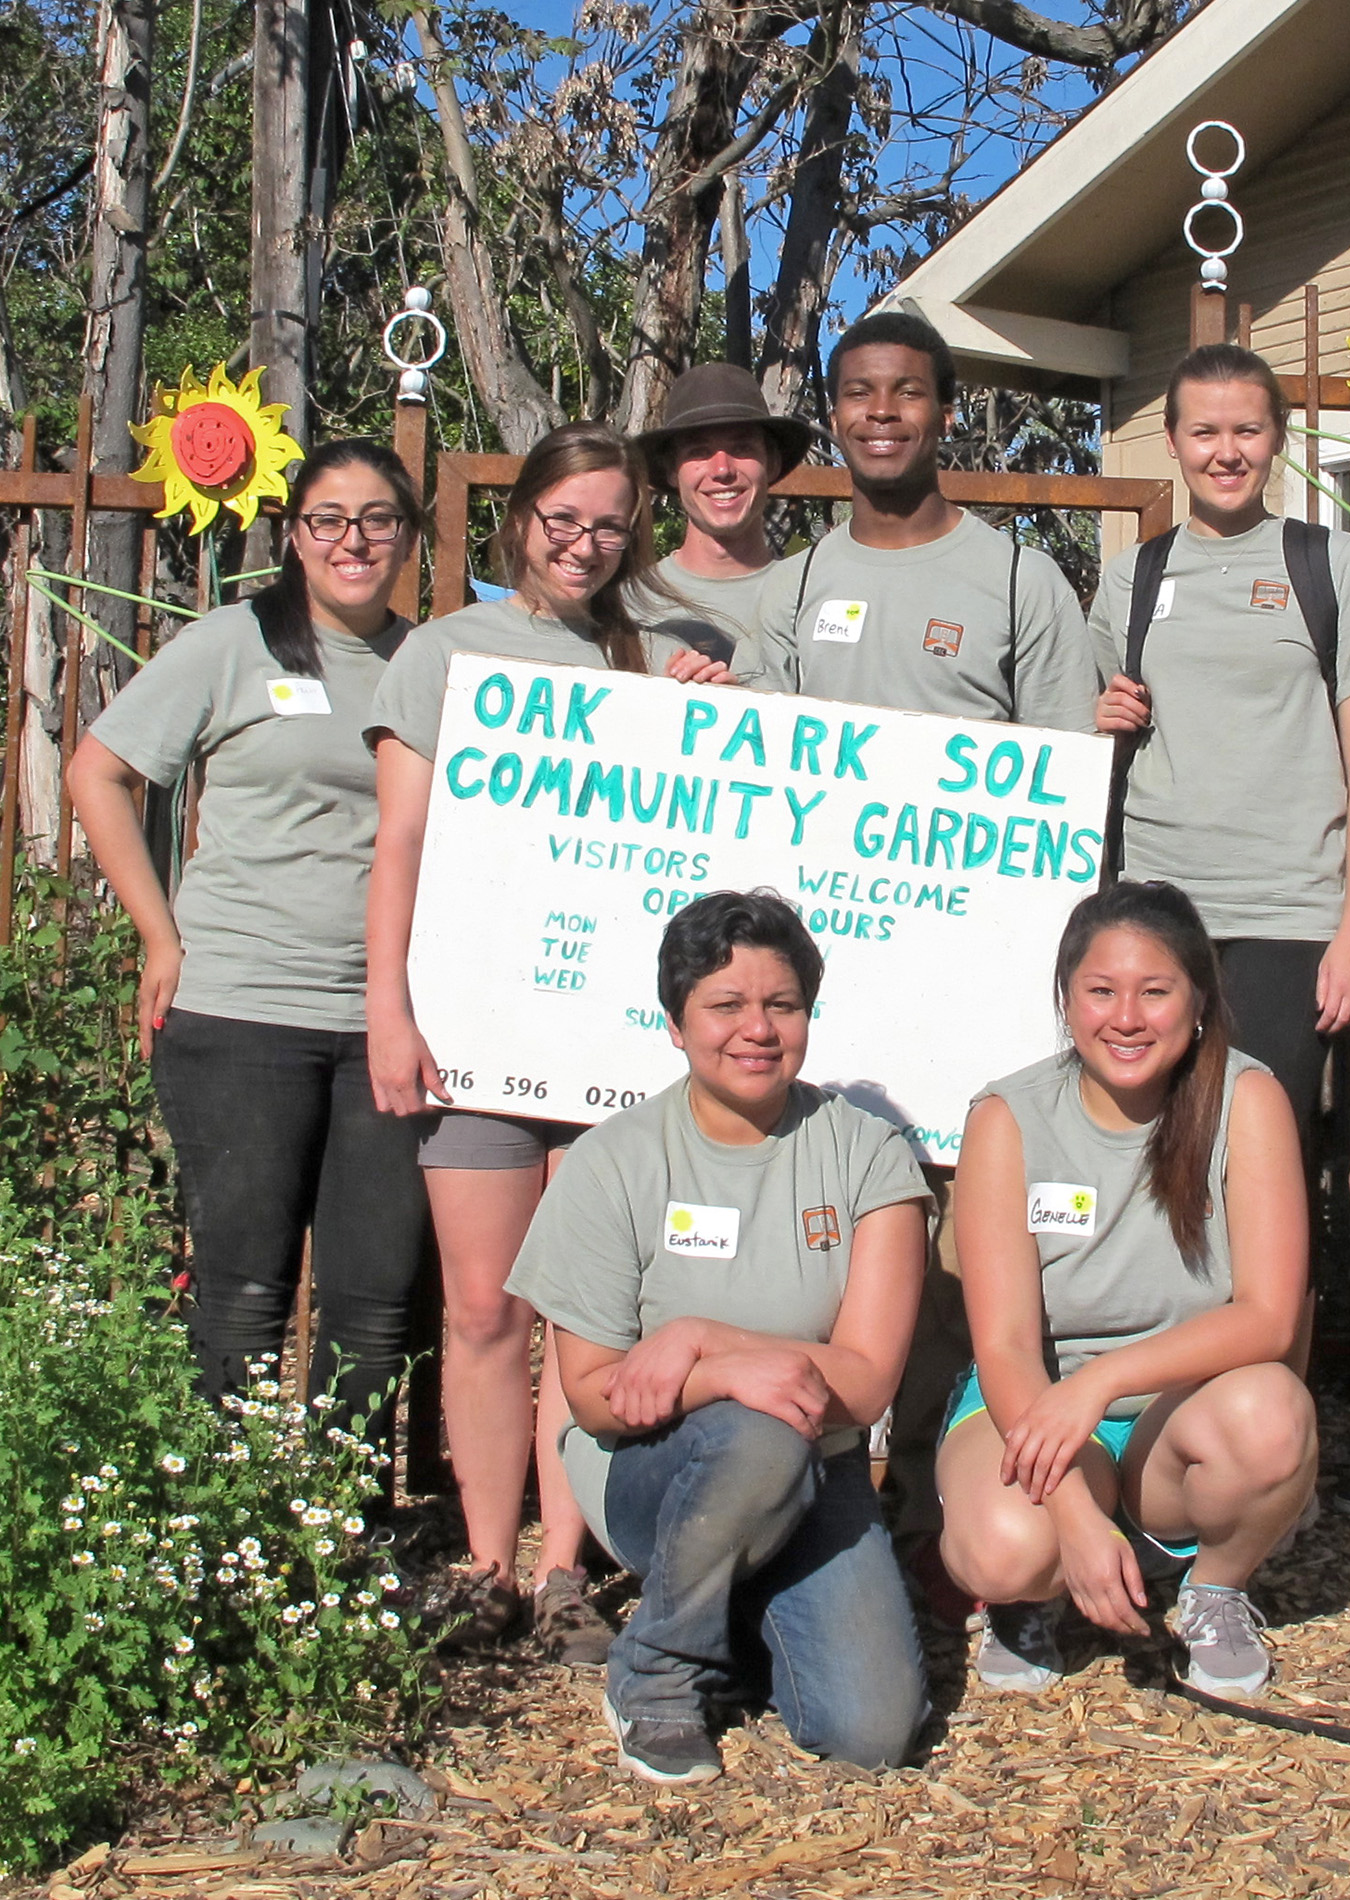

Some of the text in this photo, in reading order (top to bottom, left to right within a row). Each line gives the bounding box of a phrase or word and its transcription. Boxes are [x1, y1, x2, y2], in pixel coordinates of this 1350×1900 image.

[817, 619, 850, 637] Brent
[473, 672, 1067, 806] OAK PARK SOL
[445, 746, 1105, 883] COMMUNITY GARDENS
[548, 834, 970, 917] VISITORS WELCOME
[544, 911, 597, 934] MON
[541, 937, 592, 963] TUE
[534, 966, 586, 991] WED
[502, 1076, 548, 1100] 596
